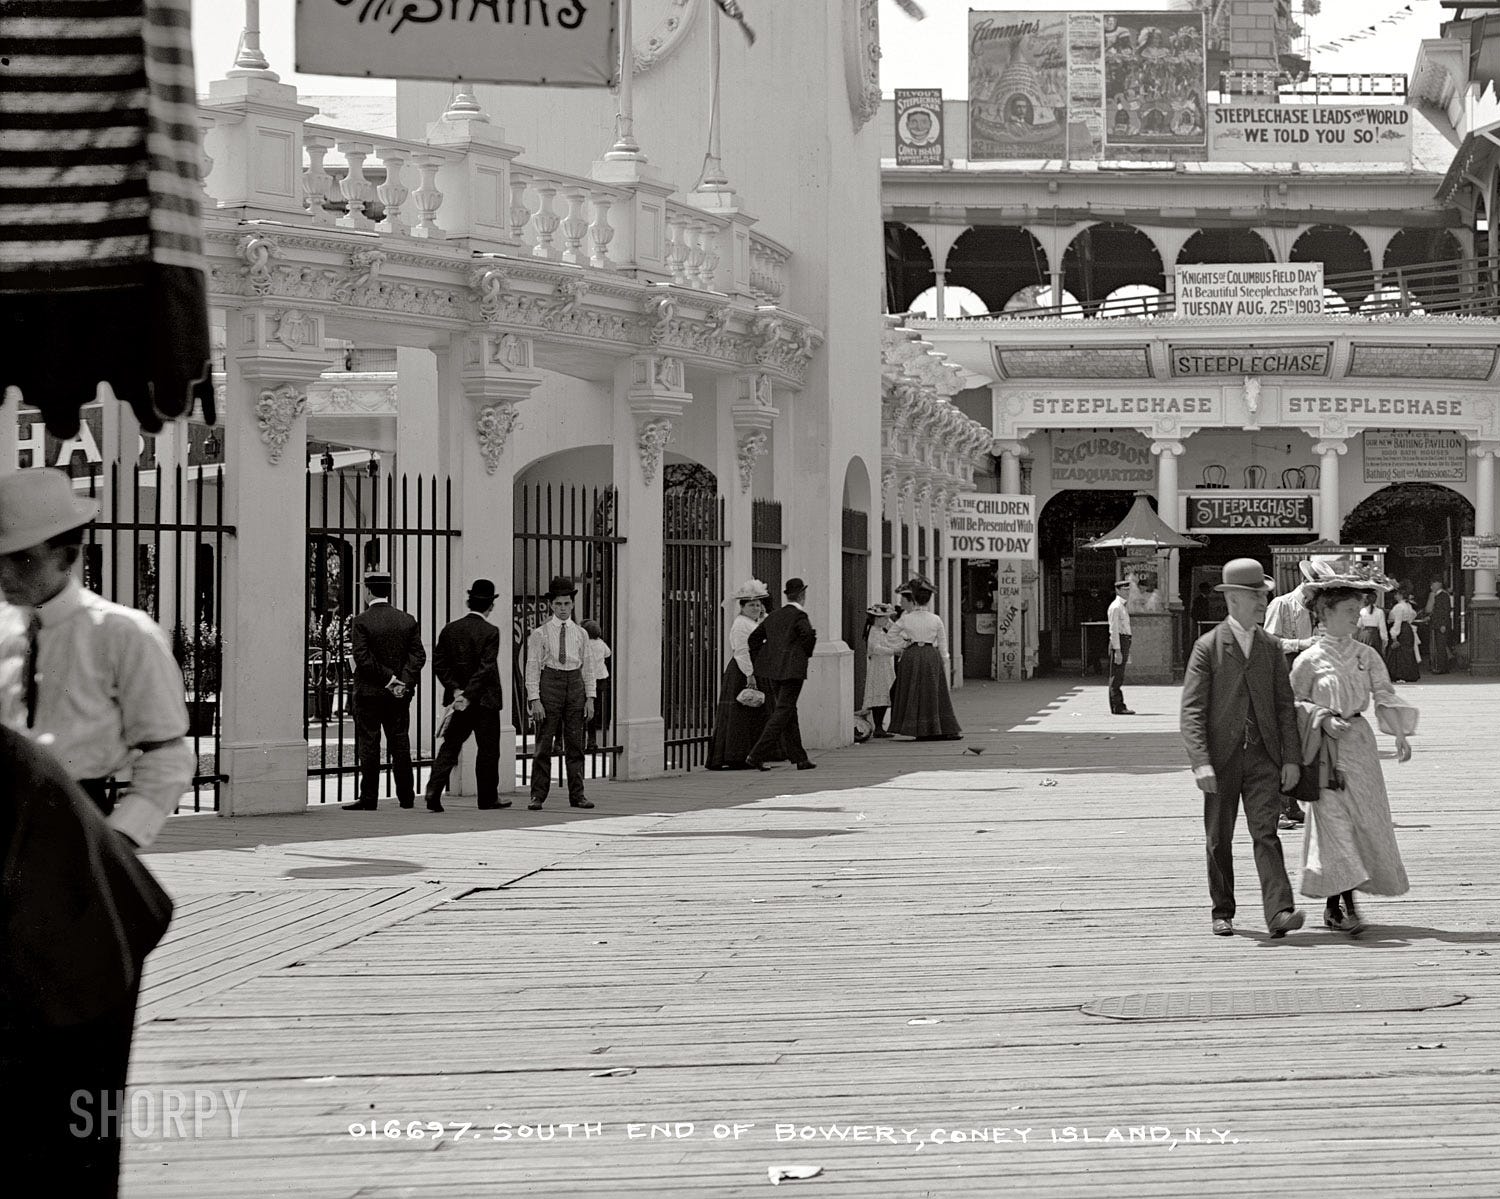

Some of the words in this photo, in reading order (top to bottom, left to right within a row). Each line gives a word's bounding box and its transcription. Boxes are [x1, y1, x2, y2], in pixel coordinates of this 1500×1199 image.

[1214, 108, 1309, 125] STEEPLECHASE
[1312, 108, 1351, 124] LEADS
[1352, 109, 1367, 119] THE
[1366, 109, 1409, 125] WORLD
[1244, 128, 1269, 143] WE
[1274, 128, 1309, 143] TOLD
[1315, 128, 1345, 143] YOU
[1353, 126, 1381, 144] SO!
[1226, 269, 1271, 284] COLUMBUS
[1272, 269, 1296, 284] FIELD
[1182, 287, 1193, 299] At
[1194, 286, 1238, 298] Beautiful
[1240, 285, 1298, 301] Steeplechase
[1299, 284, 1319, 297] Park
[1182, 301, 1233, 316] TUESDAY
[1236, 300, 1267, 316] AUG.
[1178, 353, 1323, 375] STEEPLECHASE
[1032, 397, 1212, 415] STEEPLECHASE
[1289, 397, 1463, 416] STEEPLECHASE
[1393, 438, 1424, 449] BATHING
[1424, 438, 1462, 449] PAVILION
[1053, 439, 1150, 465] EXCURSION
[1052, 467, 1154, 484] HEADQUARTERS
[1366, 468, 1392, 480] Bathing
[976, 500, 1030, 515] CHILDREN
[1196, 499, 1308, 525] STEEPLECHASE
[950, 517, 965, 531] Will
[966, 517, 977, 531] Be
[977, 517, 1016, 533] Presented
[1017, 518, 1034, 533] With
[951, 536, 985, 551] TOYS
[1463, 554, 1479, 568] 25
[1001, 577, 1017, 585] ICE
[1000, 587, 1020, 596] CREAM
[1000, 606, 1019, 635] SODA
